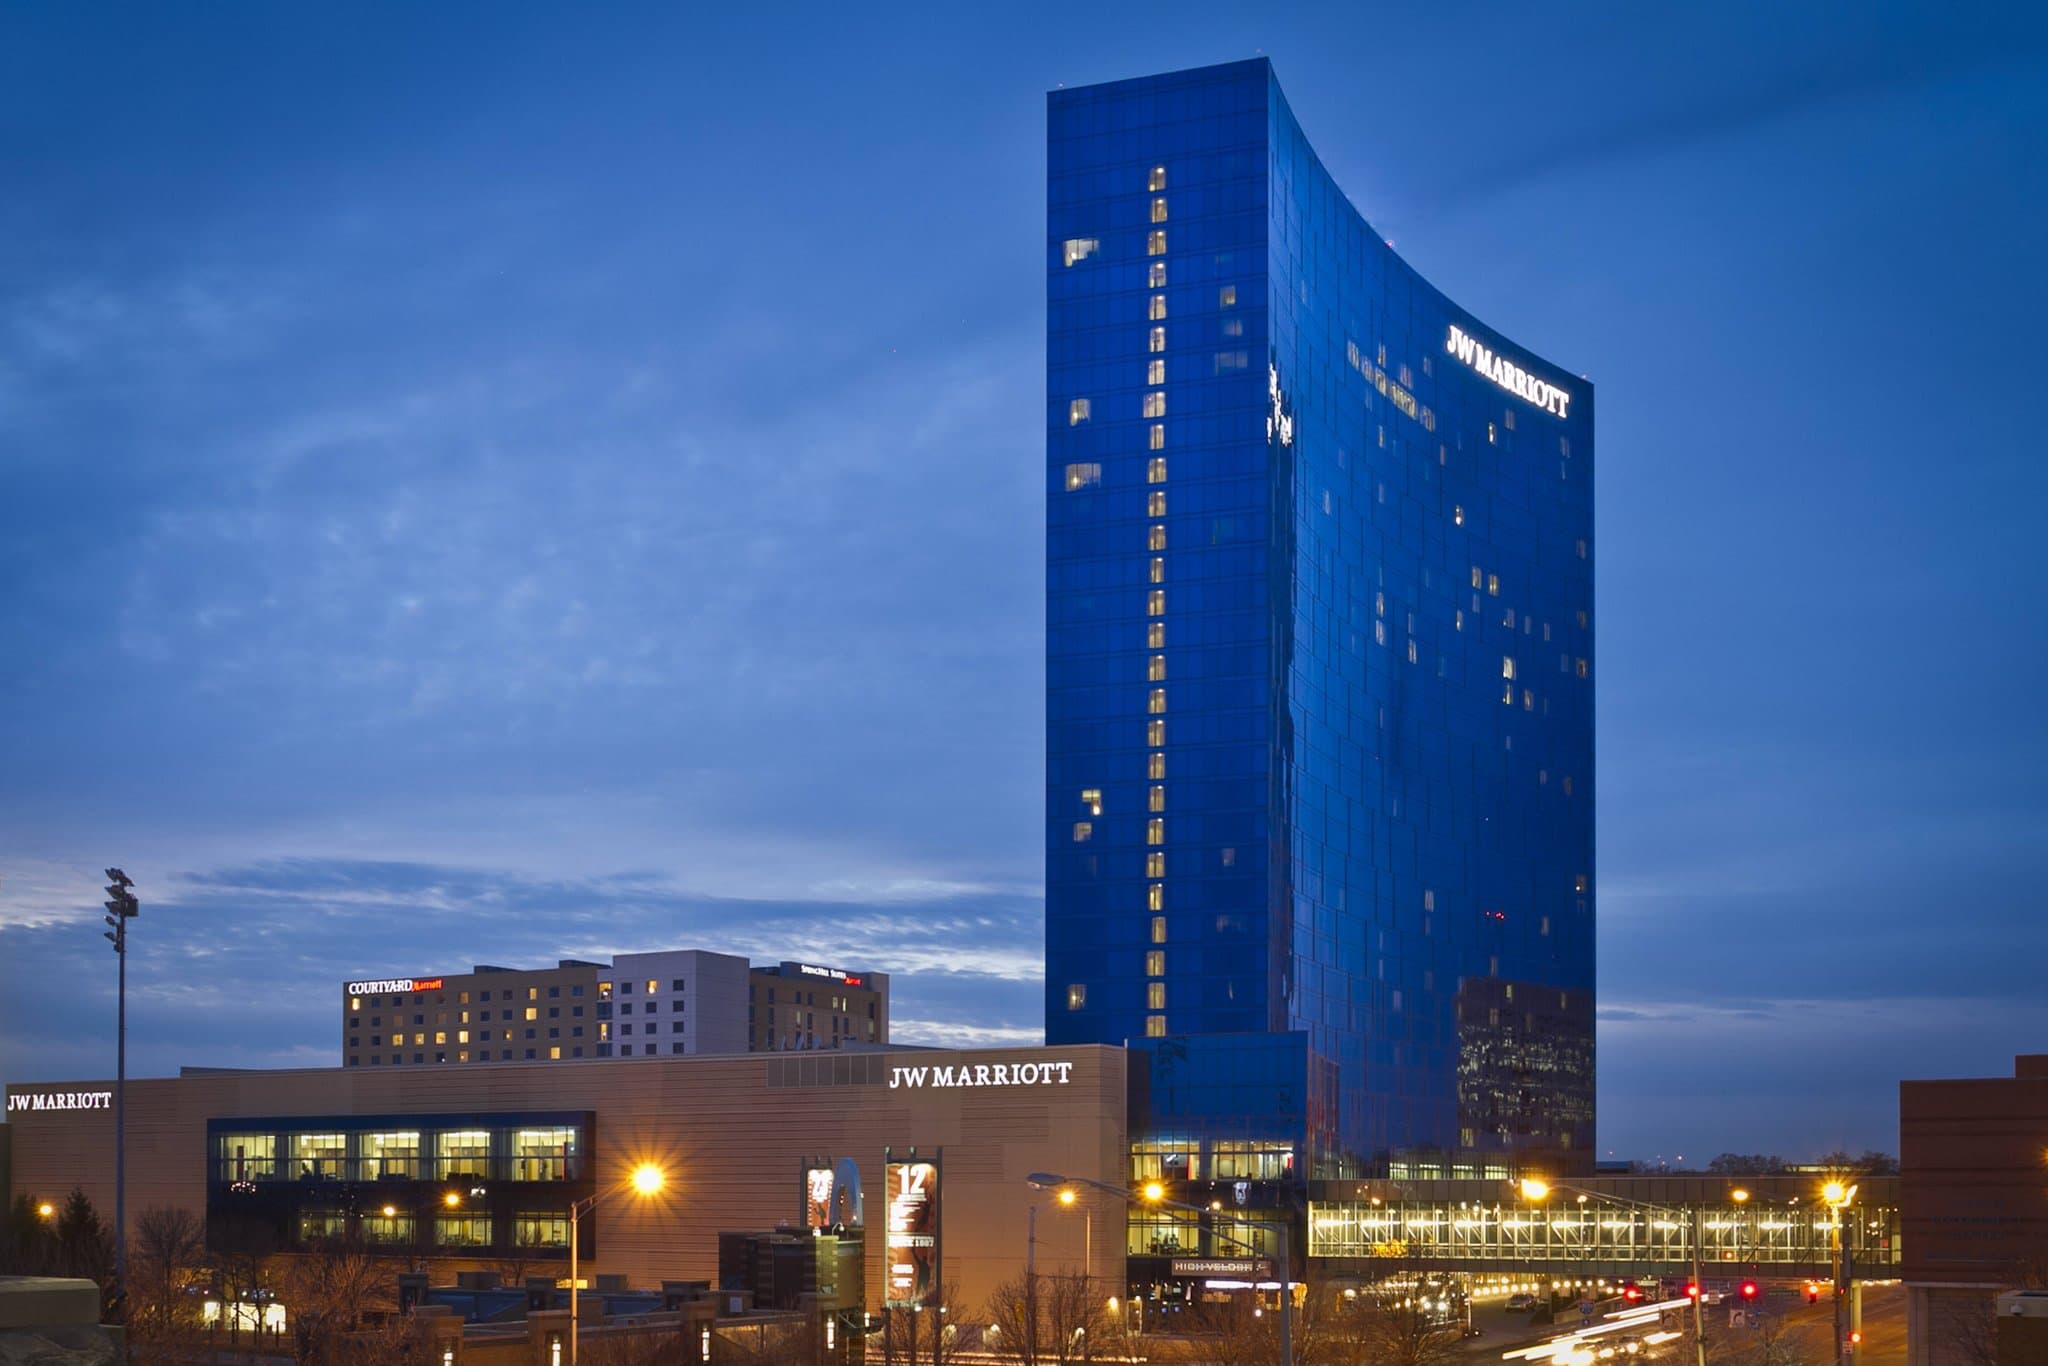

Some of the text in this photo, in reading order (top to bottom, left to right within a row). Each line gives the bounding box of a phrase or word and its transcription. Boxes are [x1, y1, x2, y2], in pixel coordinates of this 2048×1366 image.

[1447, 325, 1569, 418] JW MARRIOTT
[348, 979, 412, 995] COURTYARD
[889, 1062, 1073, 1089] JW MARRIOTT
[7, 1092, 112, 1111] JW MARRIOTT
[897, 1164, 927, 1194] 12
[1175, 1262, 1204, 1271] HIGH
